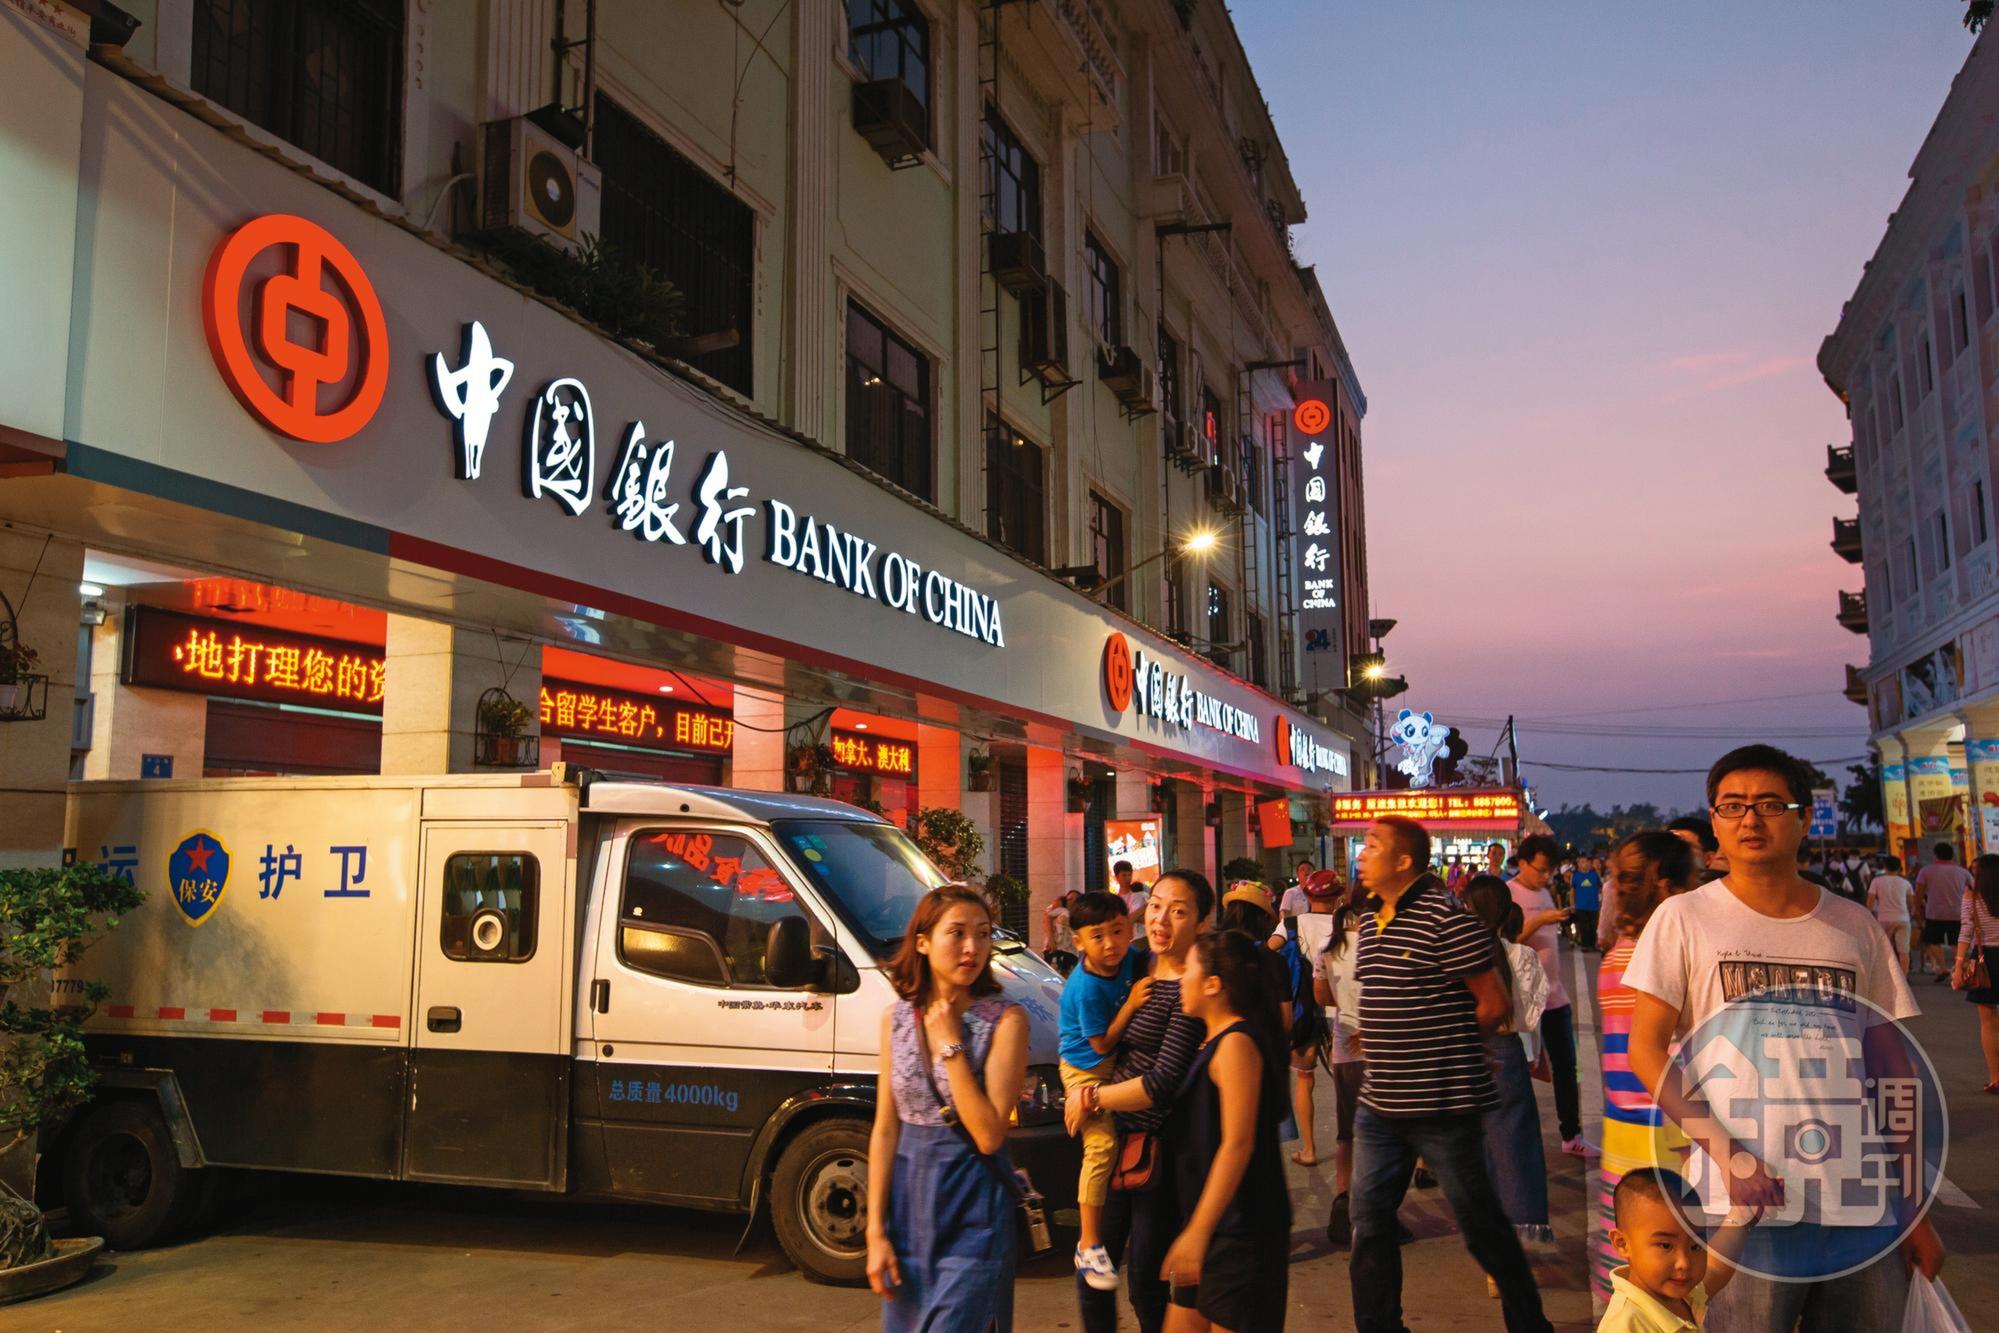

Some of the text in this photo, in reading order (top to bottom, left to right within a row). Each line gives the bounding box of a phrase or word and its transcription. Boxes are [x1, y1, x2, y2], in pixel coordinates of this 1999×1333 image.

[768, 498, 1005, 647] BANK OF CHINA
[1304, 579, 1334, 590] BANK
[1311, 589, 1326, 599] OF
[1302, 598, 1337, 609] CHINA
[1195, 690, 1260, 744] BANK OF CHINA
[178, 877, 218, 904] 保安
